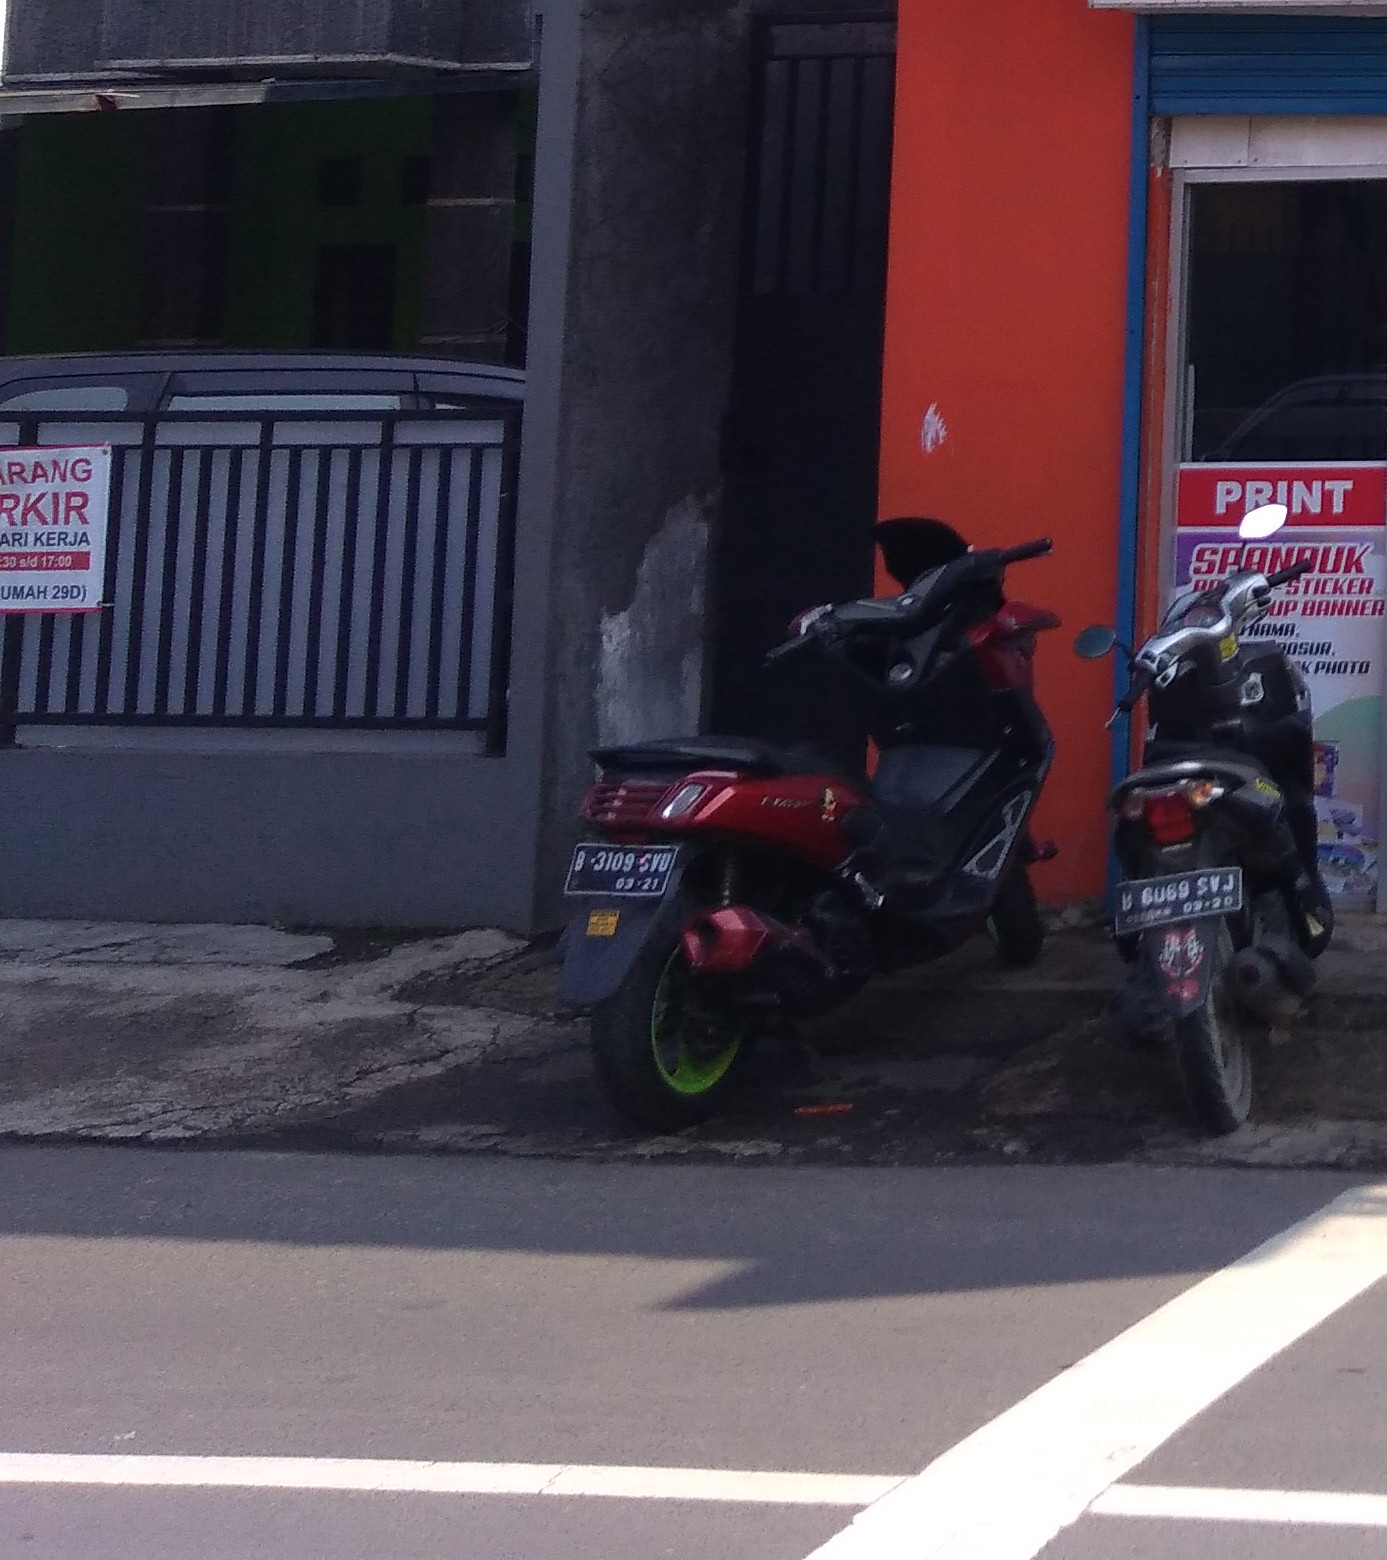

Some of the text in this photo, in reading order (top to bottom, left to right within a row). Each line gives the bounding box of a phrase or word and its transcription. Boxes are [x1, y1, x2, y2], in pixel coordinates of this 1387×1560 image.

[1216, 480, 1353, 514] PRINT
[34, 531, 90, 546] KERJA
[41, 556, 72, 568] 17:00
[1301, 599, 1386, 617] BANNER
[1314, 661, 1370, 675] PHOTO
[574, 851, 586, 872] B
